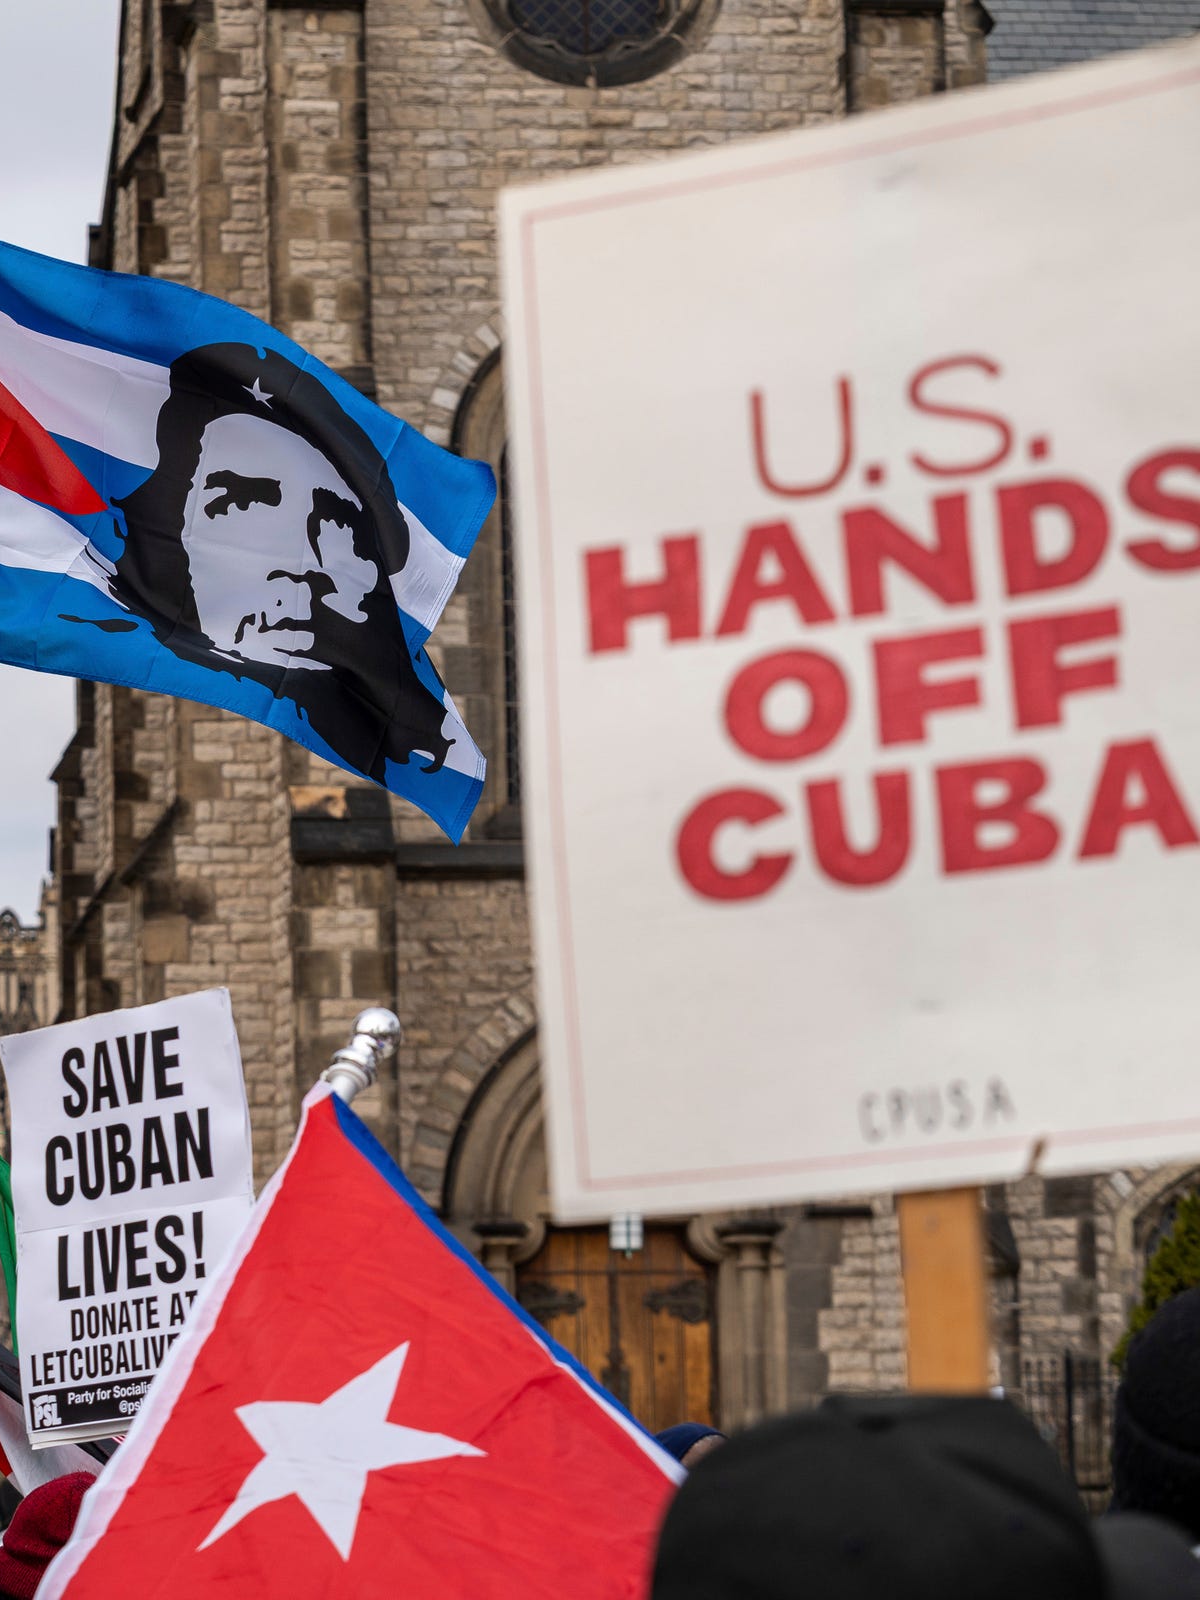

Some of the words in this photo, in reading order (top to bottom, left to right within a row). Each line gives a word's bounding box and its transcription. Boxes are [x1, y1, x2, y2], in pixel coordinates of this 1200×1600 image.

[749, 352, 1052, 499] U.S.
[583, 446, 1200, 656] HANDS
[722, 605, 1123, 763] OFF
[673, 736, 1200, 905] CUBA
[61, 1026, 184, 1118] SAVE
[858, 1074, 1017, 1142] CPUSA
[45, 1107, 214, 1206] CUBAN
[57, 1211, 207, 1300] LIVES!
[71, 1296, 160, 1341] DONATE
[33, 1403, 63, 1429] PSL
[67, 1389, 95, 1405] Party
[96, 1387, 111, 1401] for
